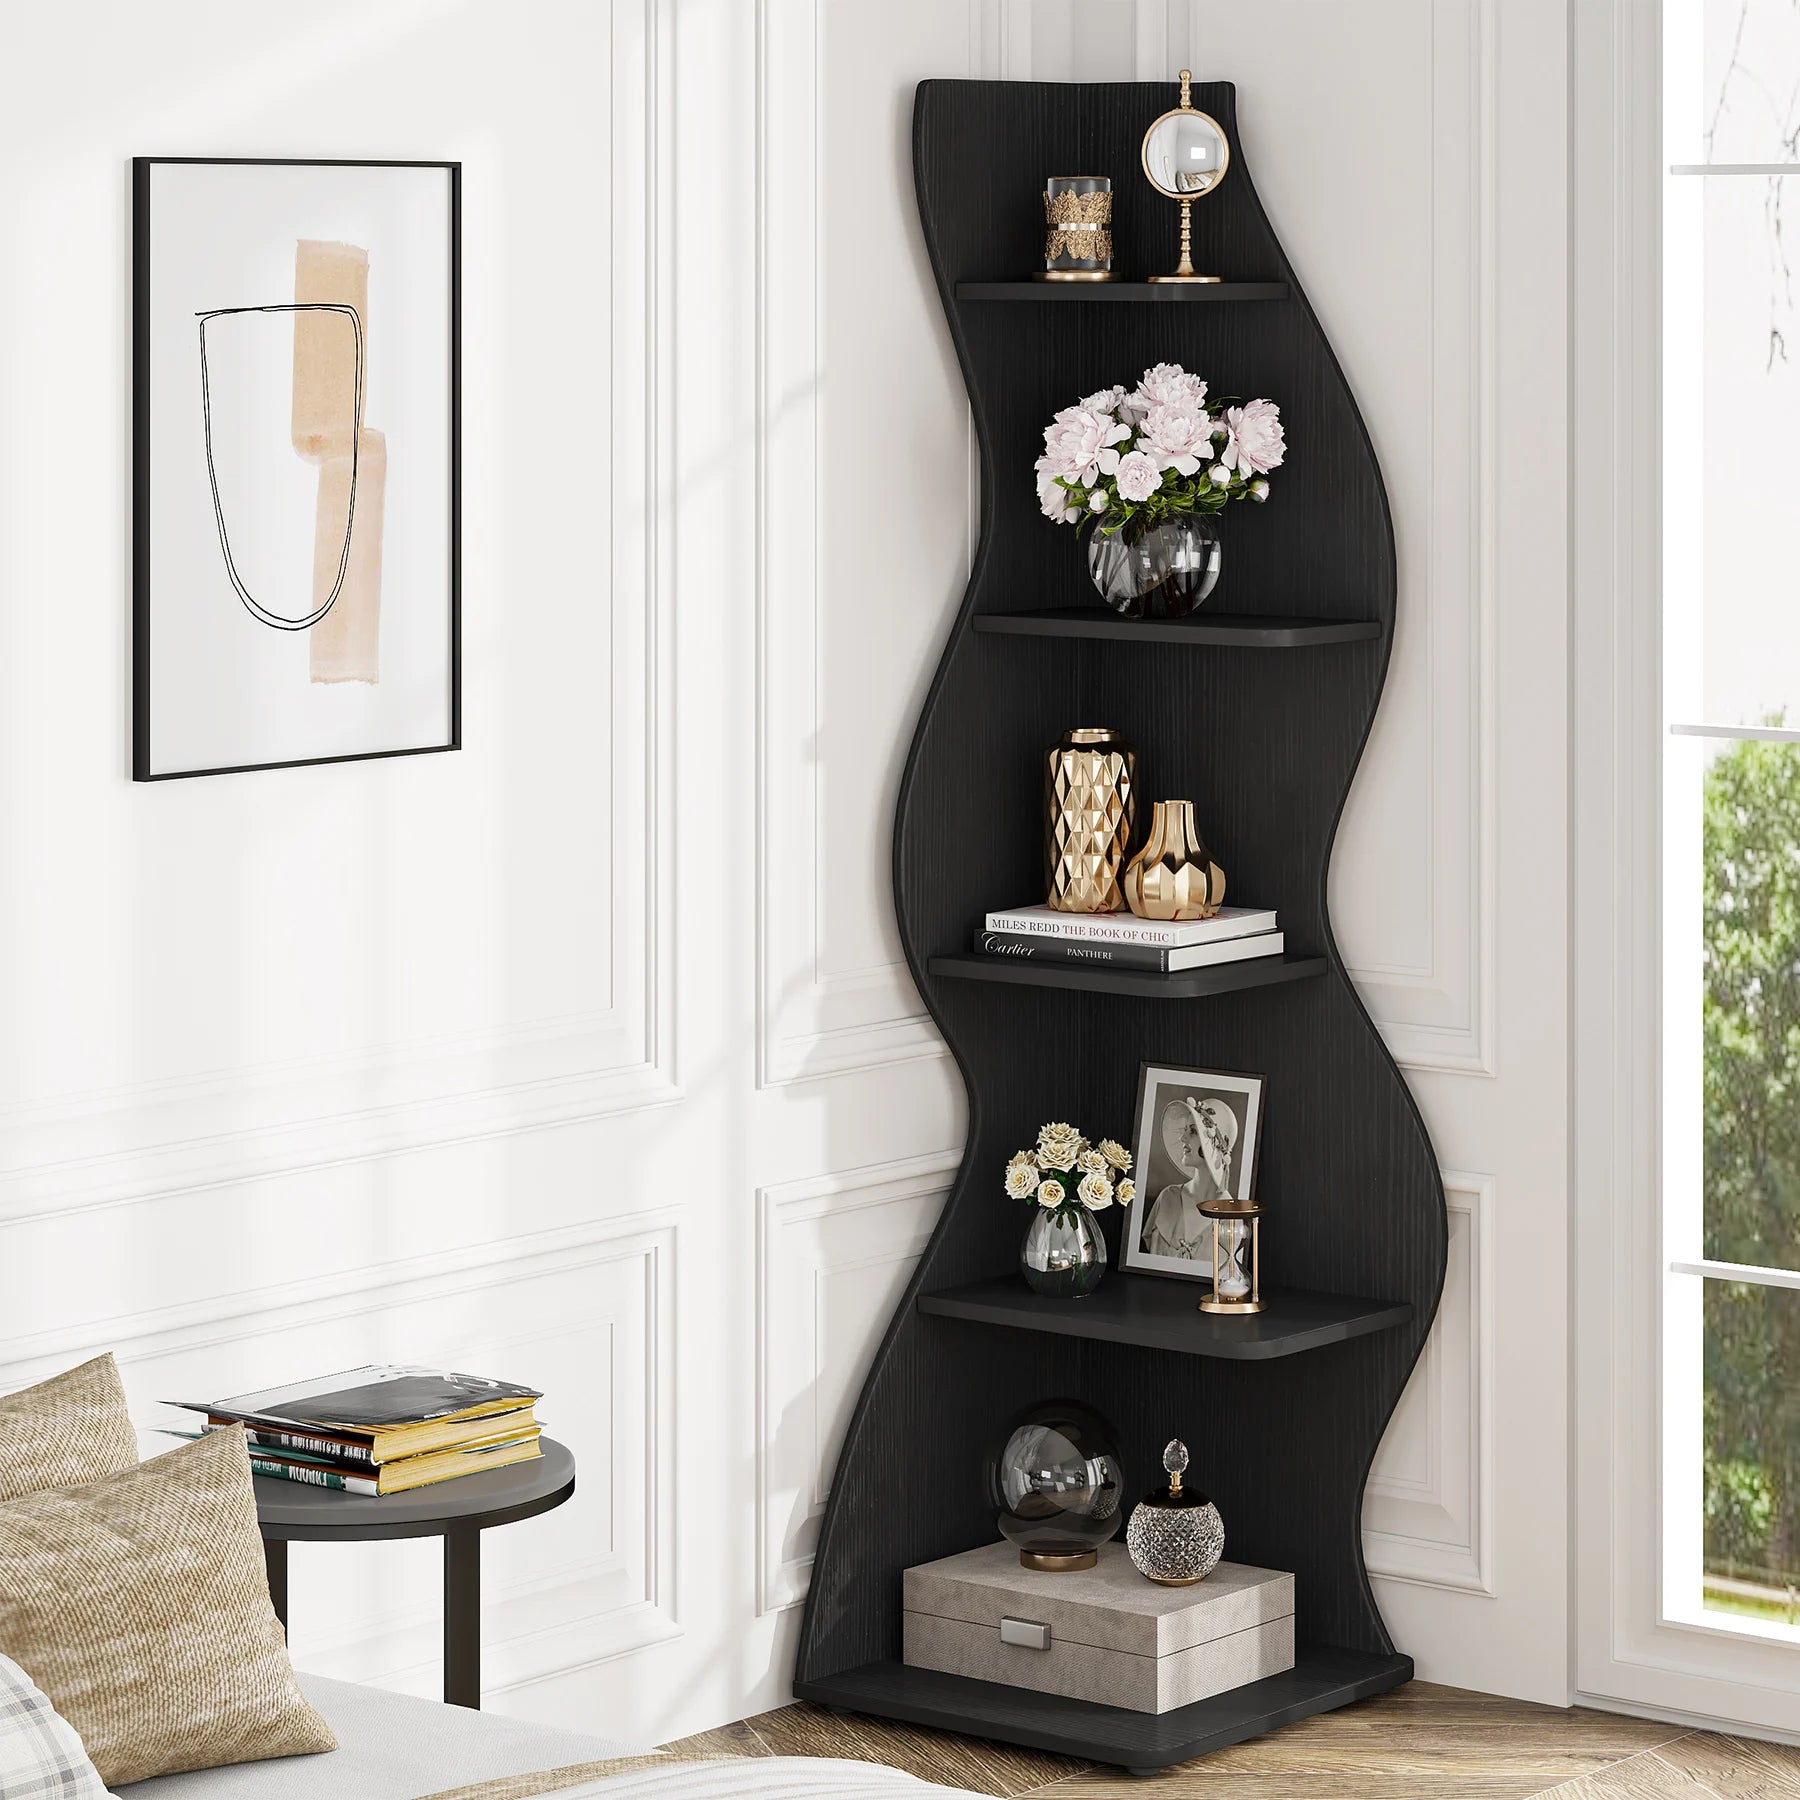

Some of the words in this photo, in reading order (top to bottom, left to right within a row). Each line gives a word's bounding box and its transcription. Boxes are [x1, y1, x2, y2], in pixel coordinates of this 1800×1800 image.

[992, 919, 1026, 930] MILES
[1029, 922, 1060, 933] REDD
[1063, 925, 1086, 936] THE
[1089, 927, 1120, 939] BOOK
[1123, 930, 1139, 940] OF
[1141, 932, 1169, 943] CHIC
[981, 932, 1035, 956] Cartier
[1067, 948, 1113, 960] PANTHERE
